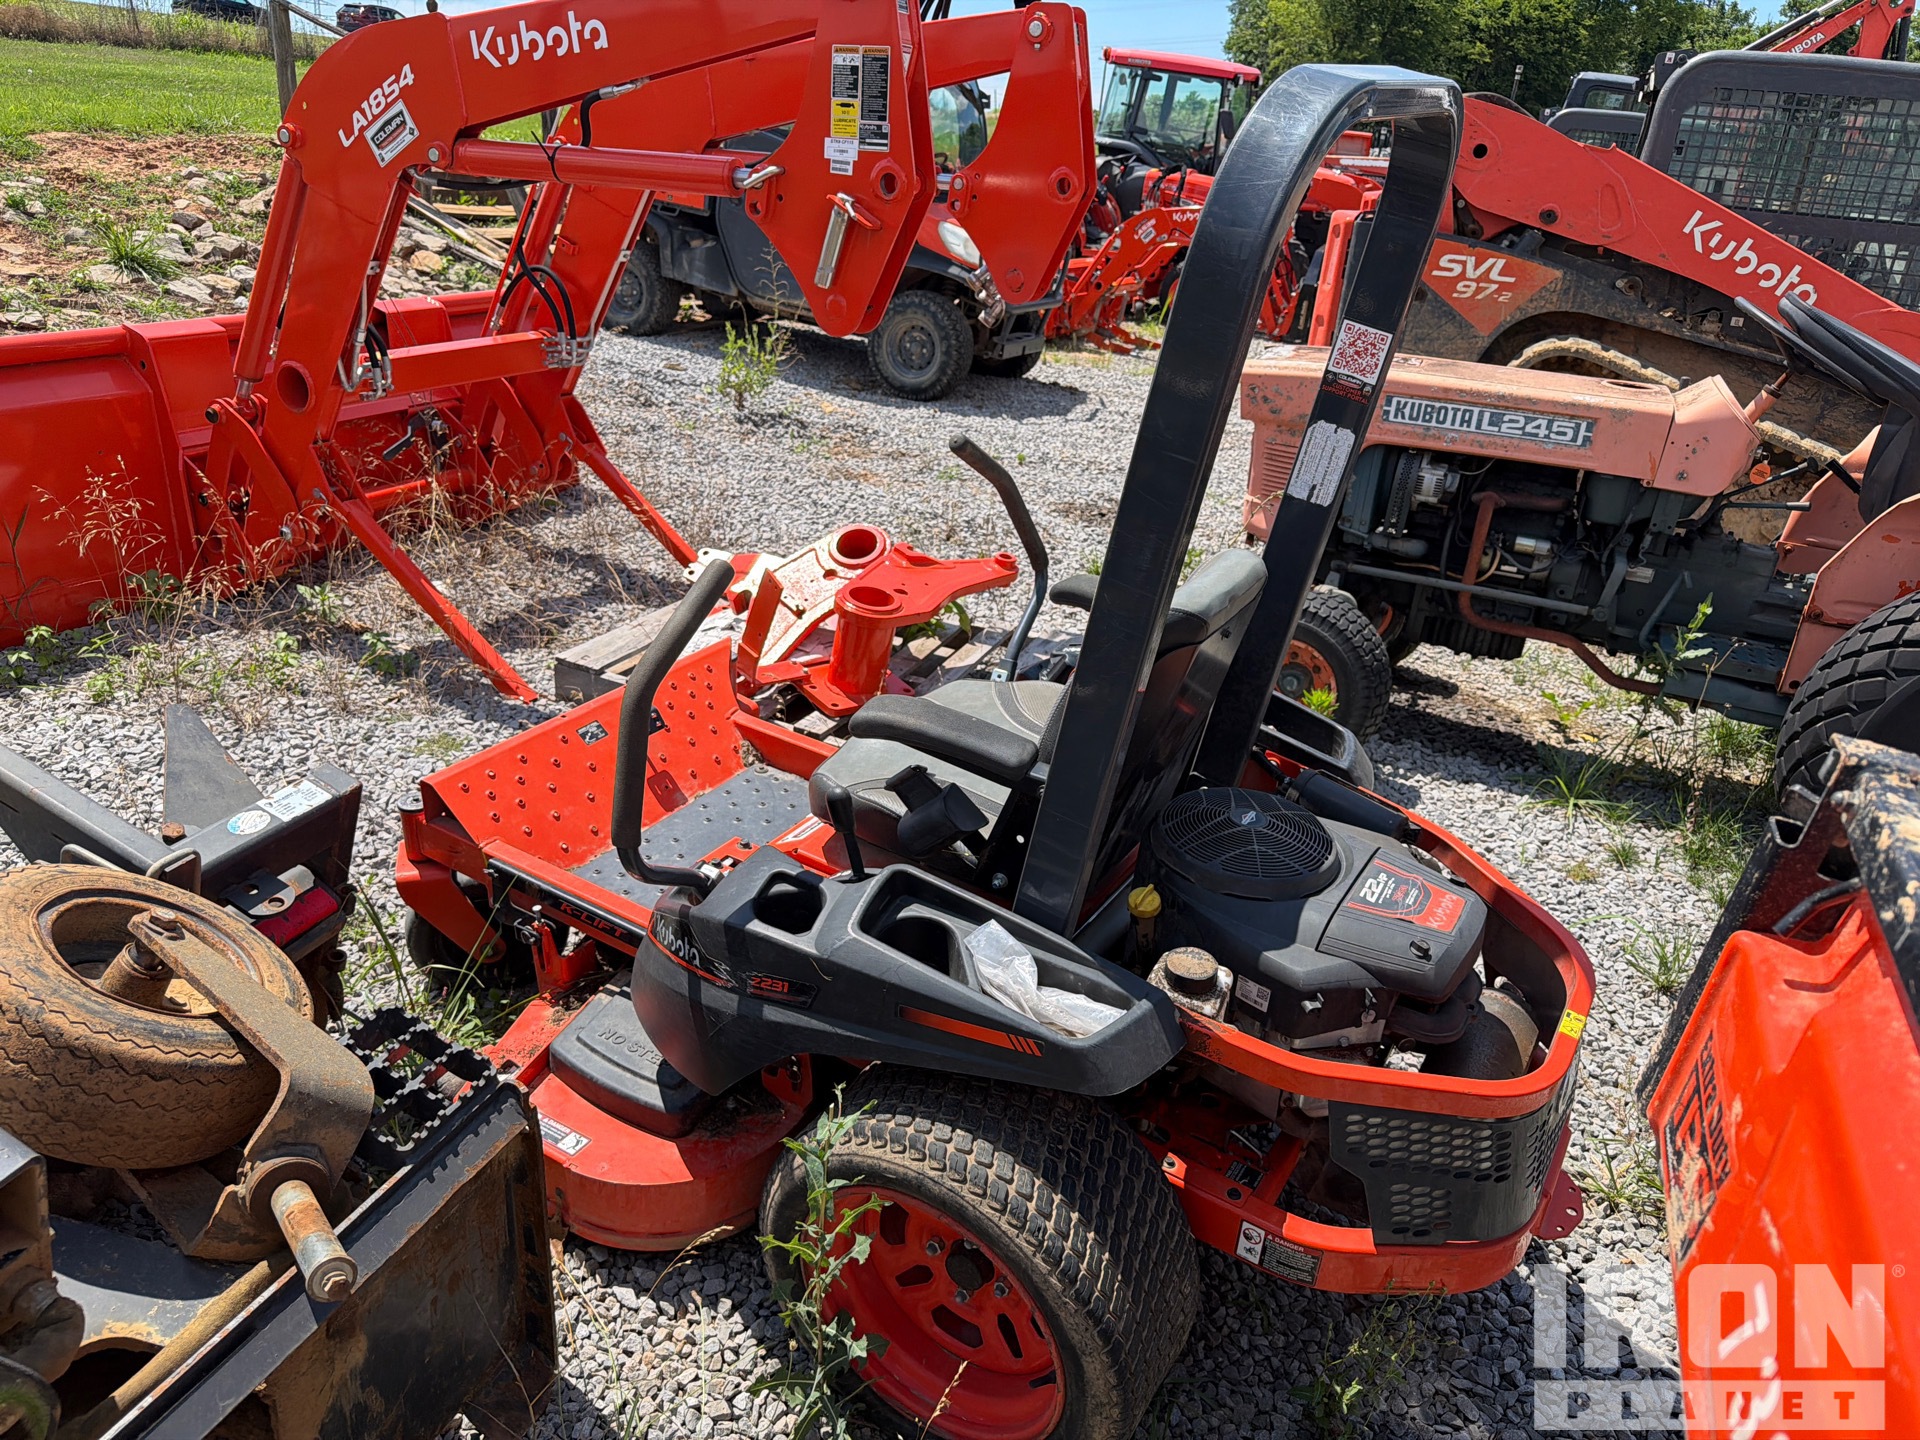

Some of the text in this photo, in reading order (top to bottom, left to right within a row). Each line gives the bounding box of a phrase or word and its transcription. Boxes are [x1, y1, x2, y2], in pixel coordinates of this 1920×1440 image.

[469, 10, 609, 68] Kubota
[338, 63, 415, 148] LA1854
[373, 114, 405, 144] COLEMAN
[1173, 211, 1200, 222] Kubo
[1431, 253, 1516, 283] SVL
[1451, 280, 1513, 302] 97-2
[1332, 382, 1362, 396] CUSTOMER
[1338, 373, 1362, 385] COLEMAN
[1322, 384, 1369, 405] SUPPORT PORTAL
[1393, 399, 1576, 441] KUBOTA L245
[560, 902, 630, 937] K-LIFT
[1425, 893, 1458, 929] Kubota
[656, 916, 701, 967] Kubota
[751, 976, 789, 993] Z231
[597, 1028, 664, 1067] NO STE
[549, 1118, 571, 1132] DANGER
[1275, 1236, 1304, 1252] DANGER
